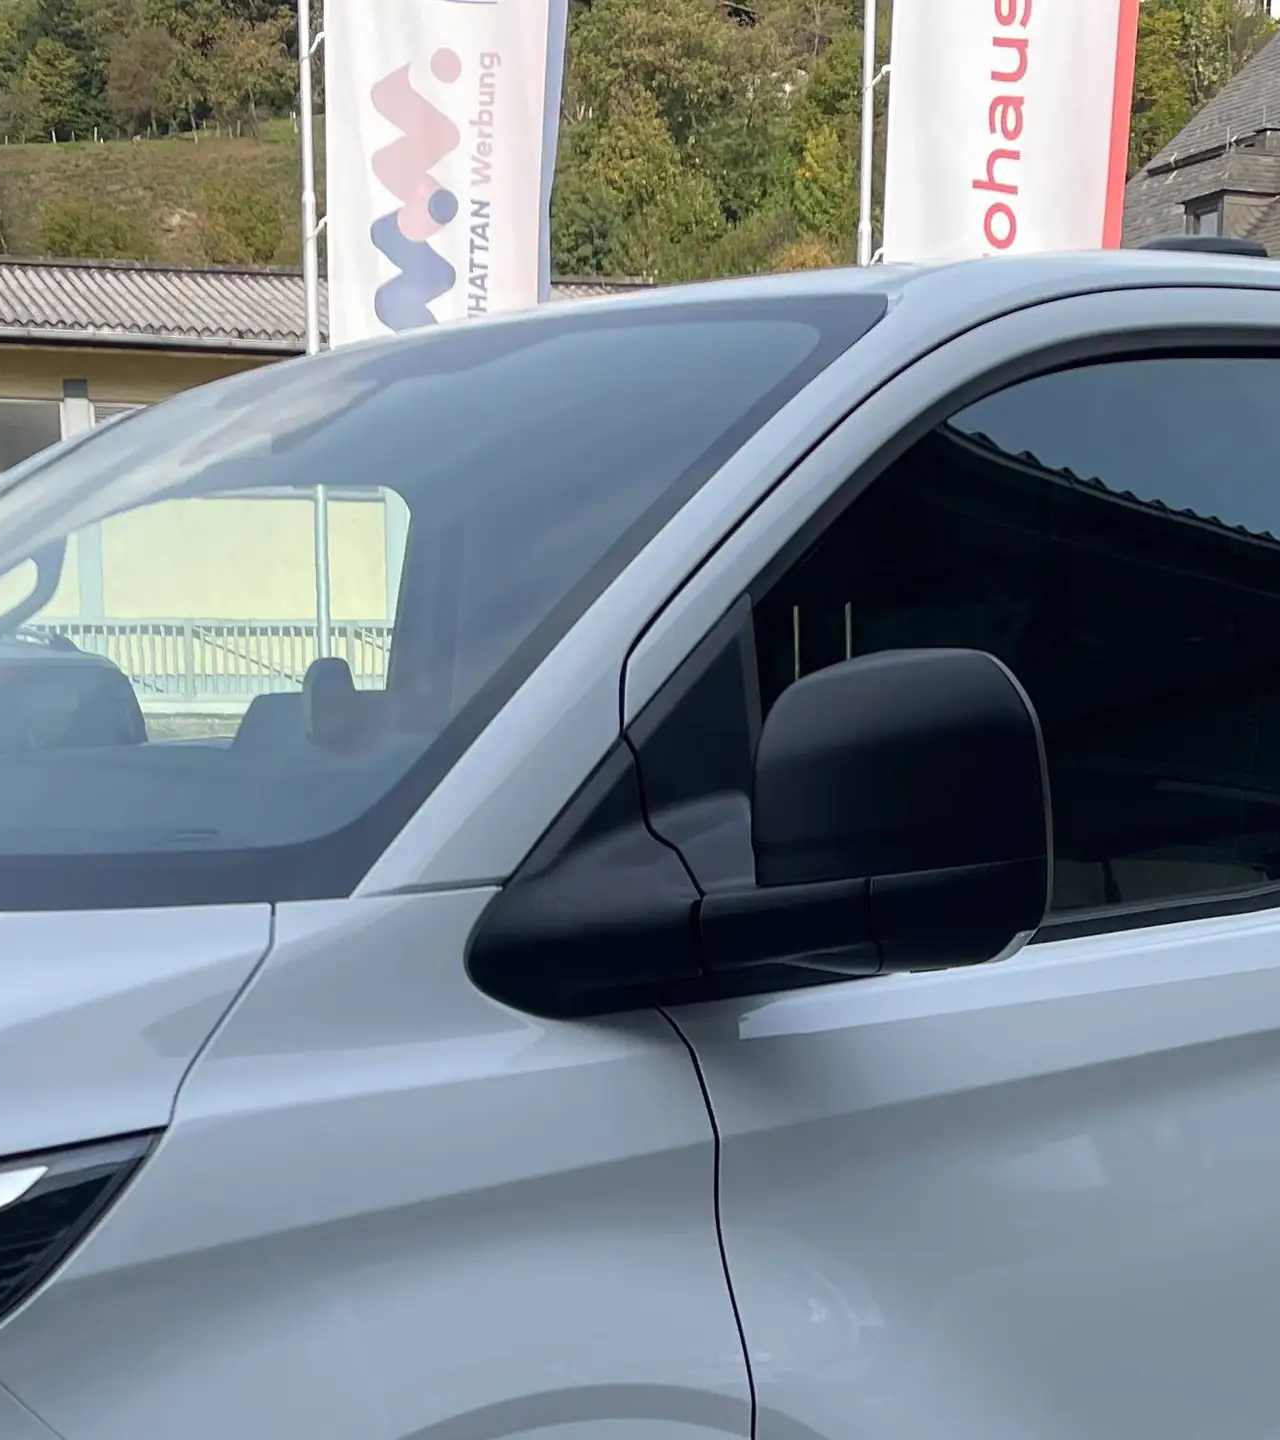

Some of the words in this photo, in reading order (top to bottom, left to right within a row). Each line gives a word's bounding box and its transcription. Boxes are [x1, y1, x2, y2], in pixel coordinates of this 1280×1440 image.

[469, 52, 501, 186] Werbung
[972, 0, 1032, 256] ohaus
[467, 199, 491, 318] HATTAN
